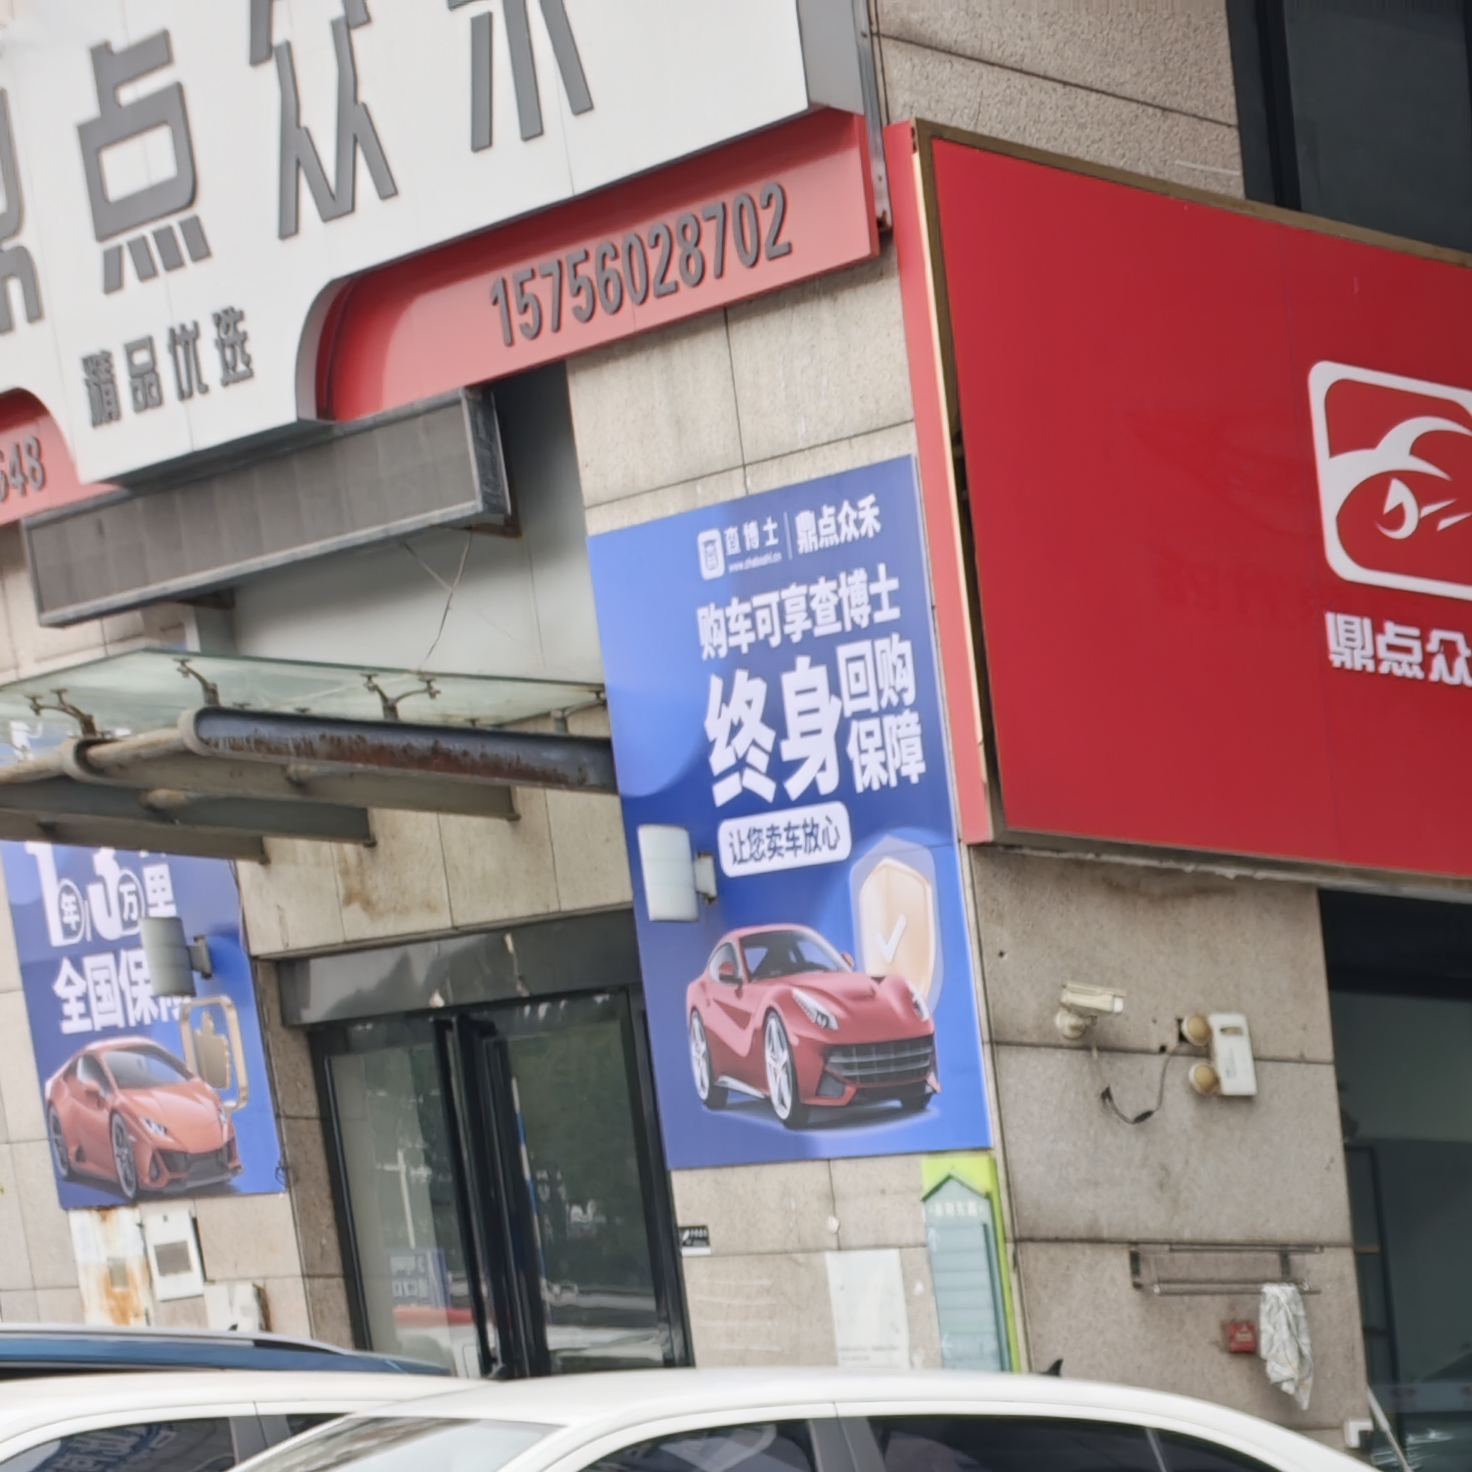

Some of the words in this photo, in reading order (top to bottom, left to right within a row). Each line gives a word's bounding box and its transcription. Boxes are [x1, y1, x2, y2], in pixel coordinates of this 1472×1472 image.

[491, 182, 793, 347] 15756028702
[81, 306, 253, 429] 精品优选
[697, 562, 900, 660] 购车可享查博士
[836, 632, 916, 718] 回购
[704, 656, 842, 807] 终身
[847, 711, 926, 793] 保障
[729, 815, 841, 866] 让您卖车放心
[53, 947, 193, 1034] 全国保
